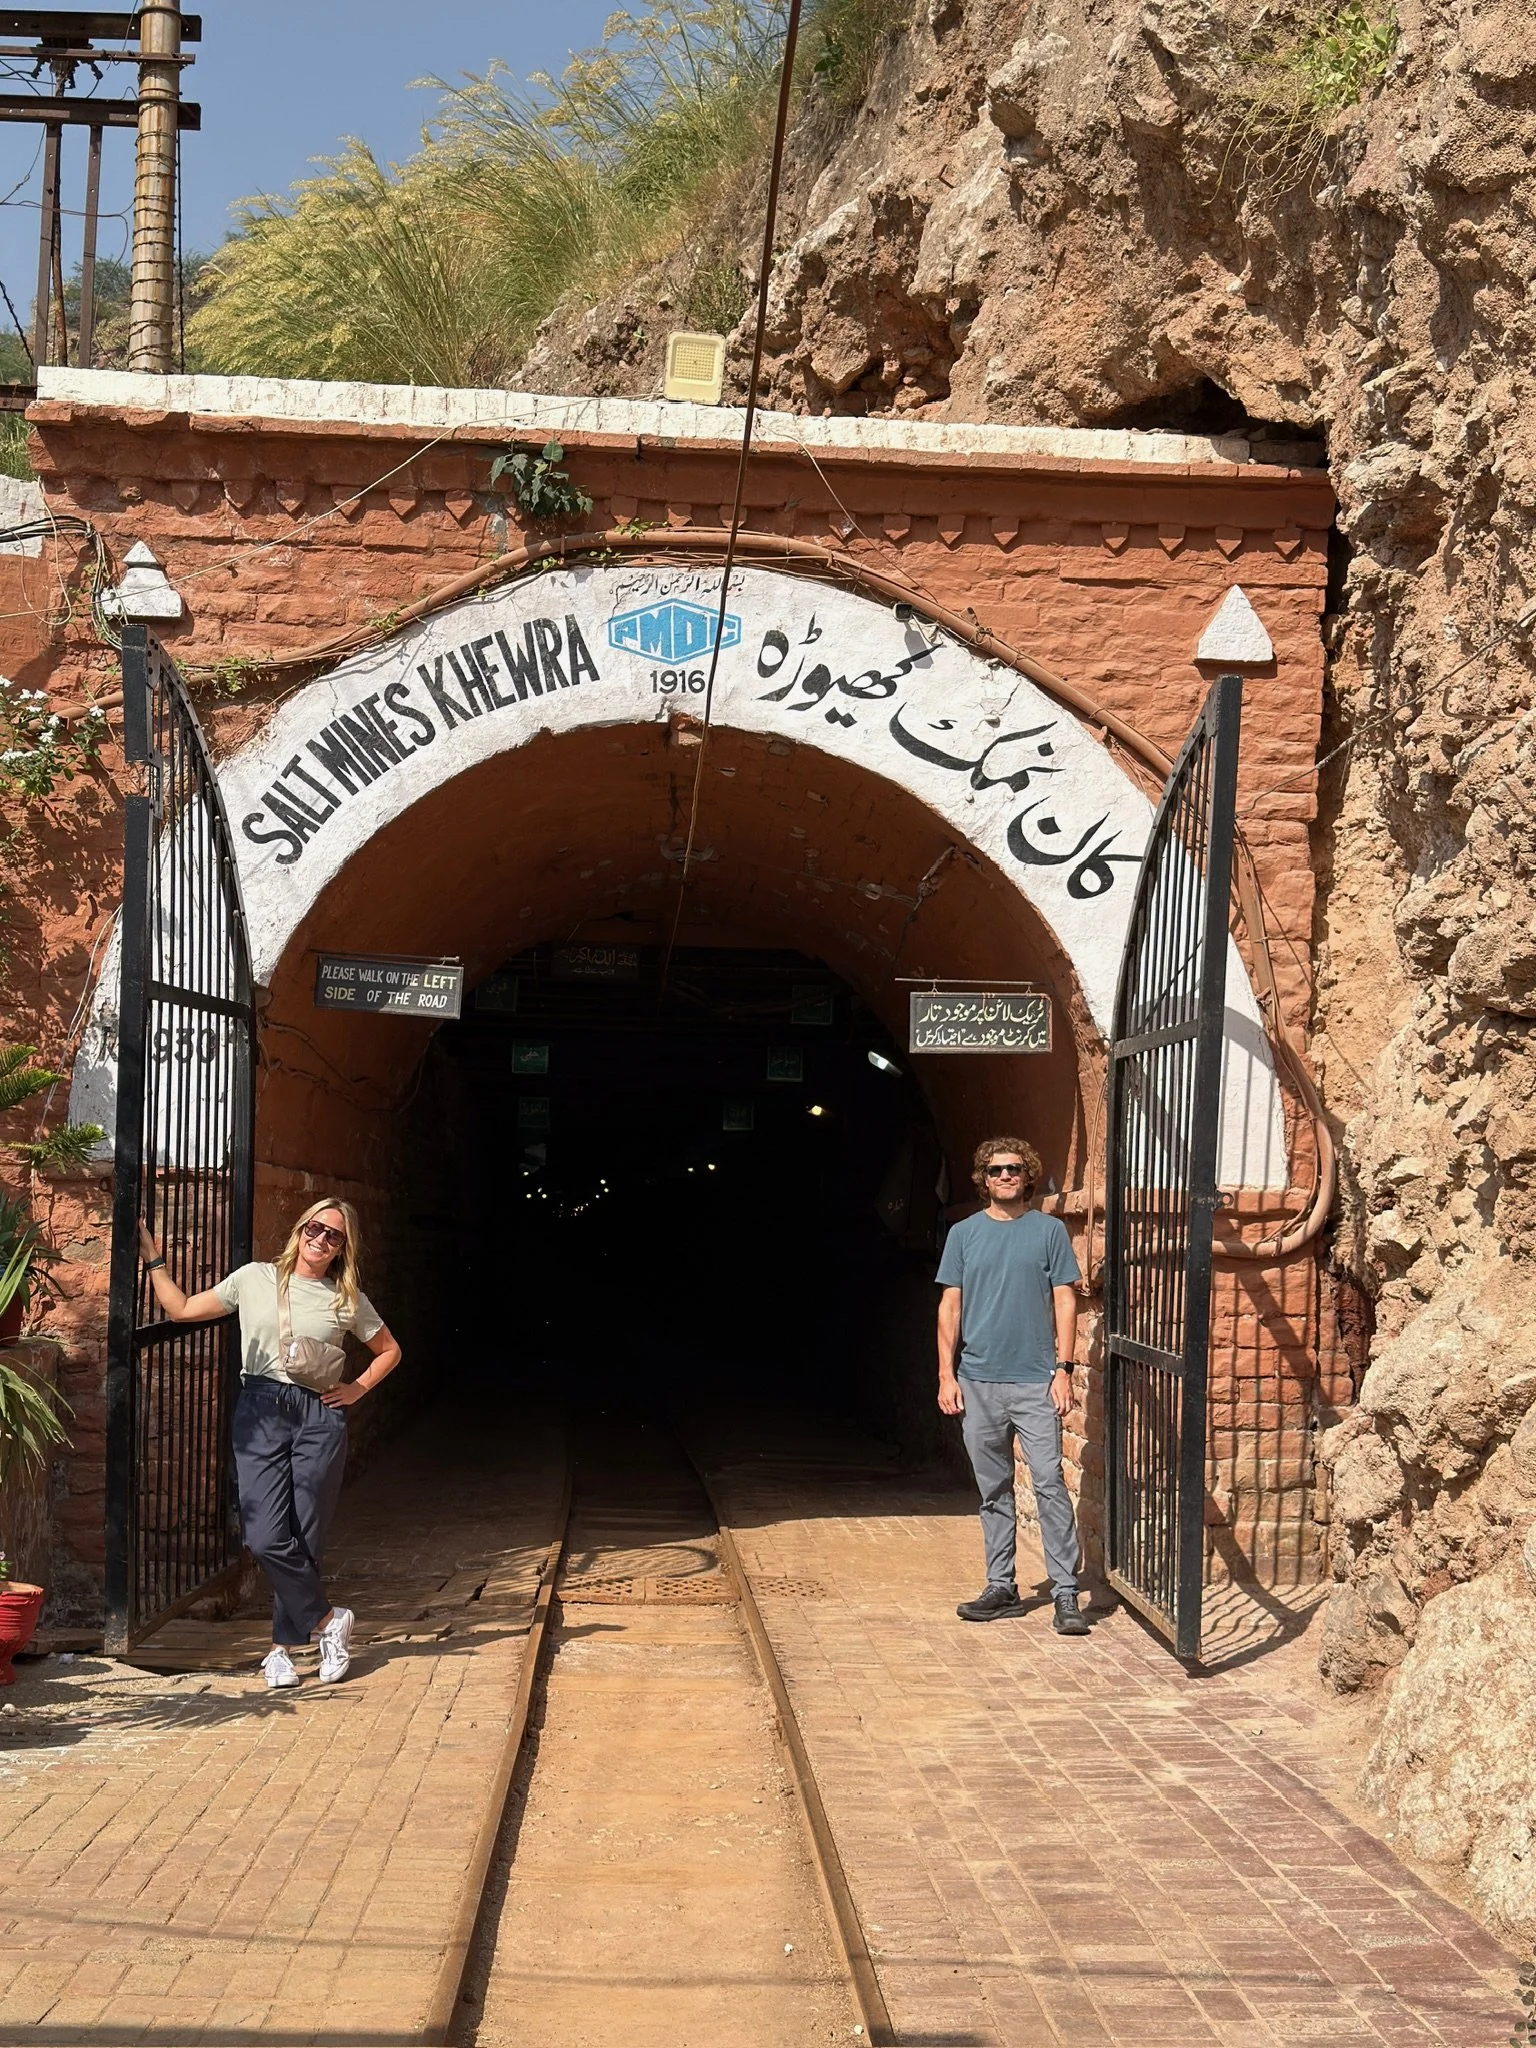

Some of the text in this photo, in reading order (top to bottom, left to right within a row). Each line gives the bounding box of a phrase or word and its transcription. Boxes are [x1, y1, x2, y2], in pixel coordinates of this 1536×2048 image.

[614, 604, 738, 660] PMDC
[650, 669, 706, 694] 1916
[241, 613, 601, 865] SALT MINES KHEWRA
[756, 612, 1146, 899] کان نمک کھیوڑہ
[321, 965, 457, 990] PLEASE WALK ON THE LEFT
[324, 986, 448, 1008] SIDE OF THE ROAD
[918, 1003, 943, 1024] تار
[939, 1003, 977, 1022] موجود
[968, 1007, 984, 1025] پر
[976, 1028, 1006, 1046] موجود
[1002, 1024, 1037, 1046] کرنٹ
